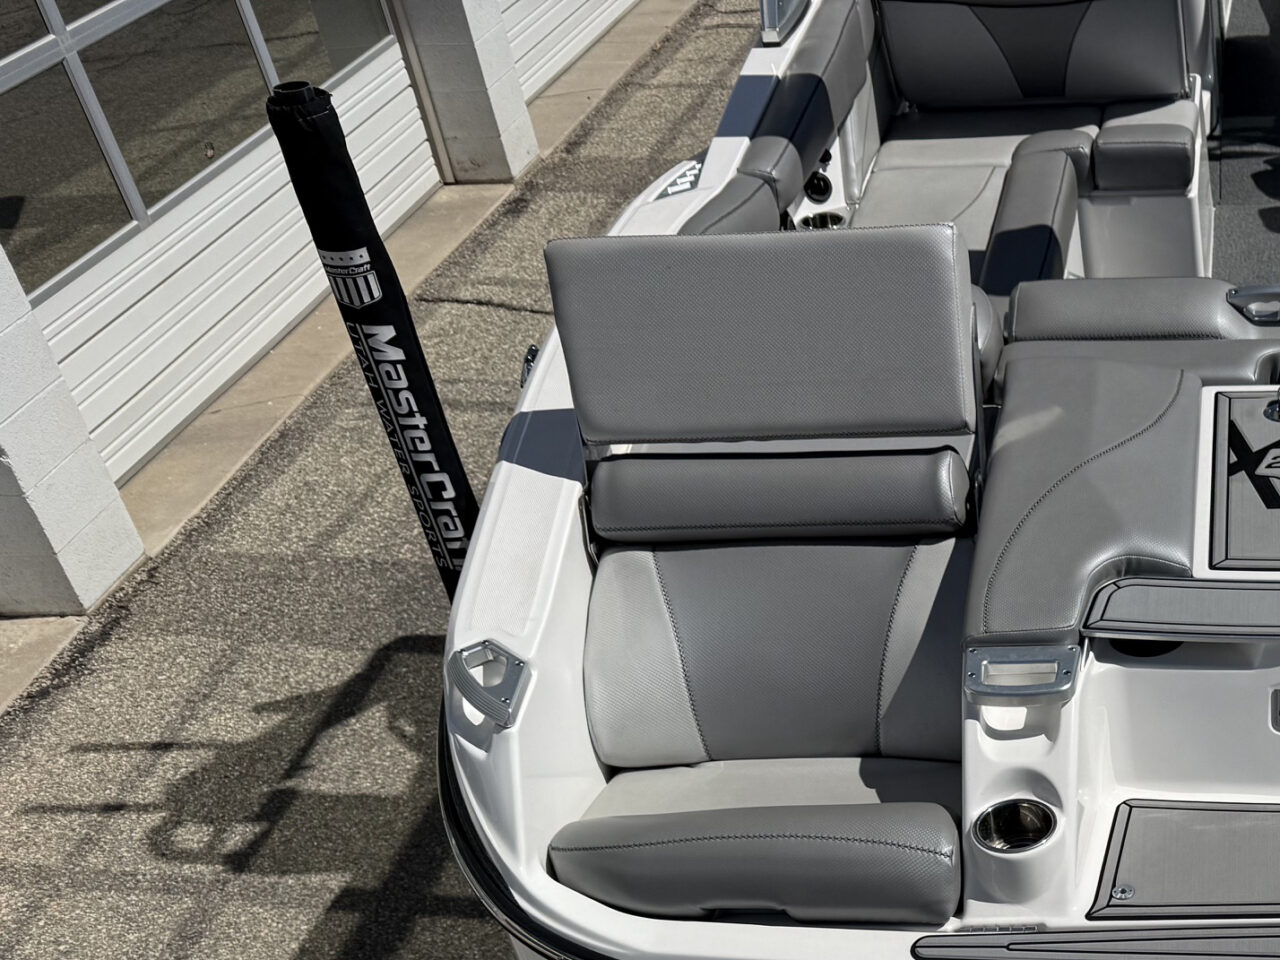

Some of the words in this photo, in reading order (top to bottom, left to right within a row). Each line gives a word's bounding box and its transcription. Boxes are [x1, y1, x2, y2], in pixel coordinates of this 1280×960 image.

[346, 321, 378, 389] UTAH
[376, 399, 410, 475] WATER
[408, 483, 448, 567] SPORTS
